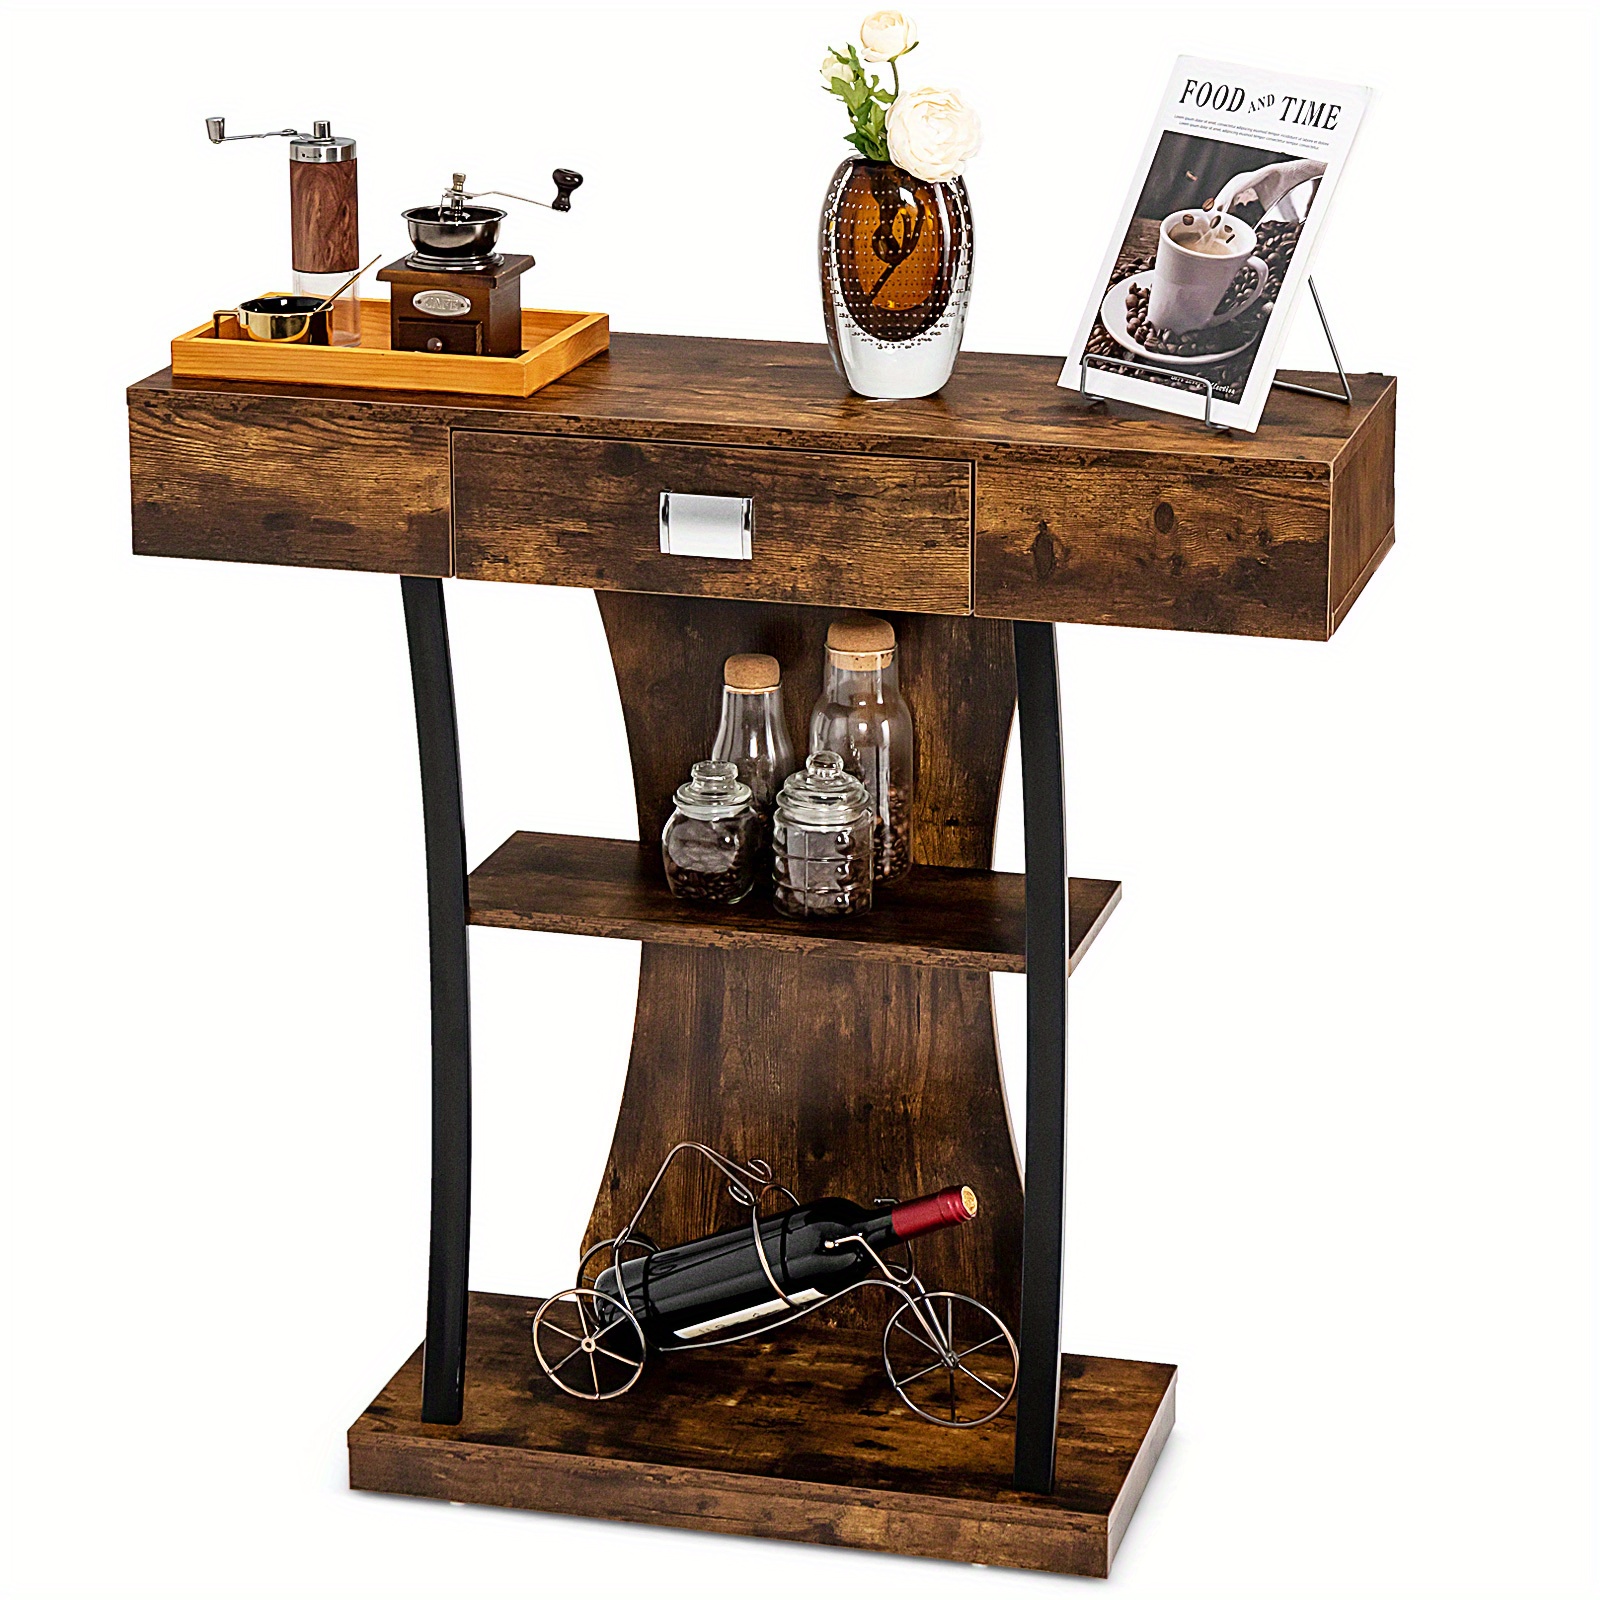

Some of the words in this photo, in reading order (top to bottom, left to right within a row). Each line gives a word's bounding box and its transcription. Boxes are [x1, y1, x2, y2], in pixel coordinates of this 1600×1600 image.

[1179, 79, 1246, 113] FOOD
[1248, 94, 1275, 114] AND
[1279, 95, 1342, 131] TIME
